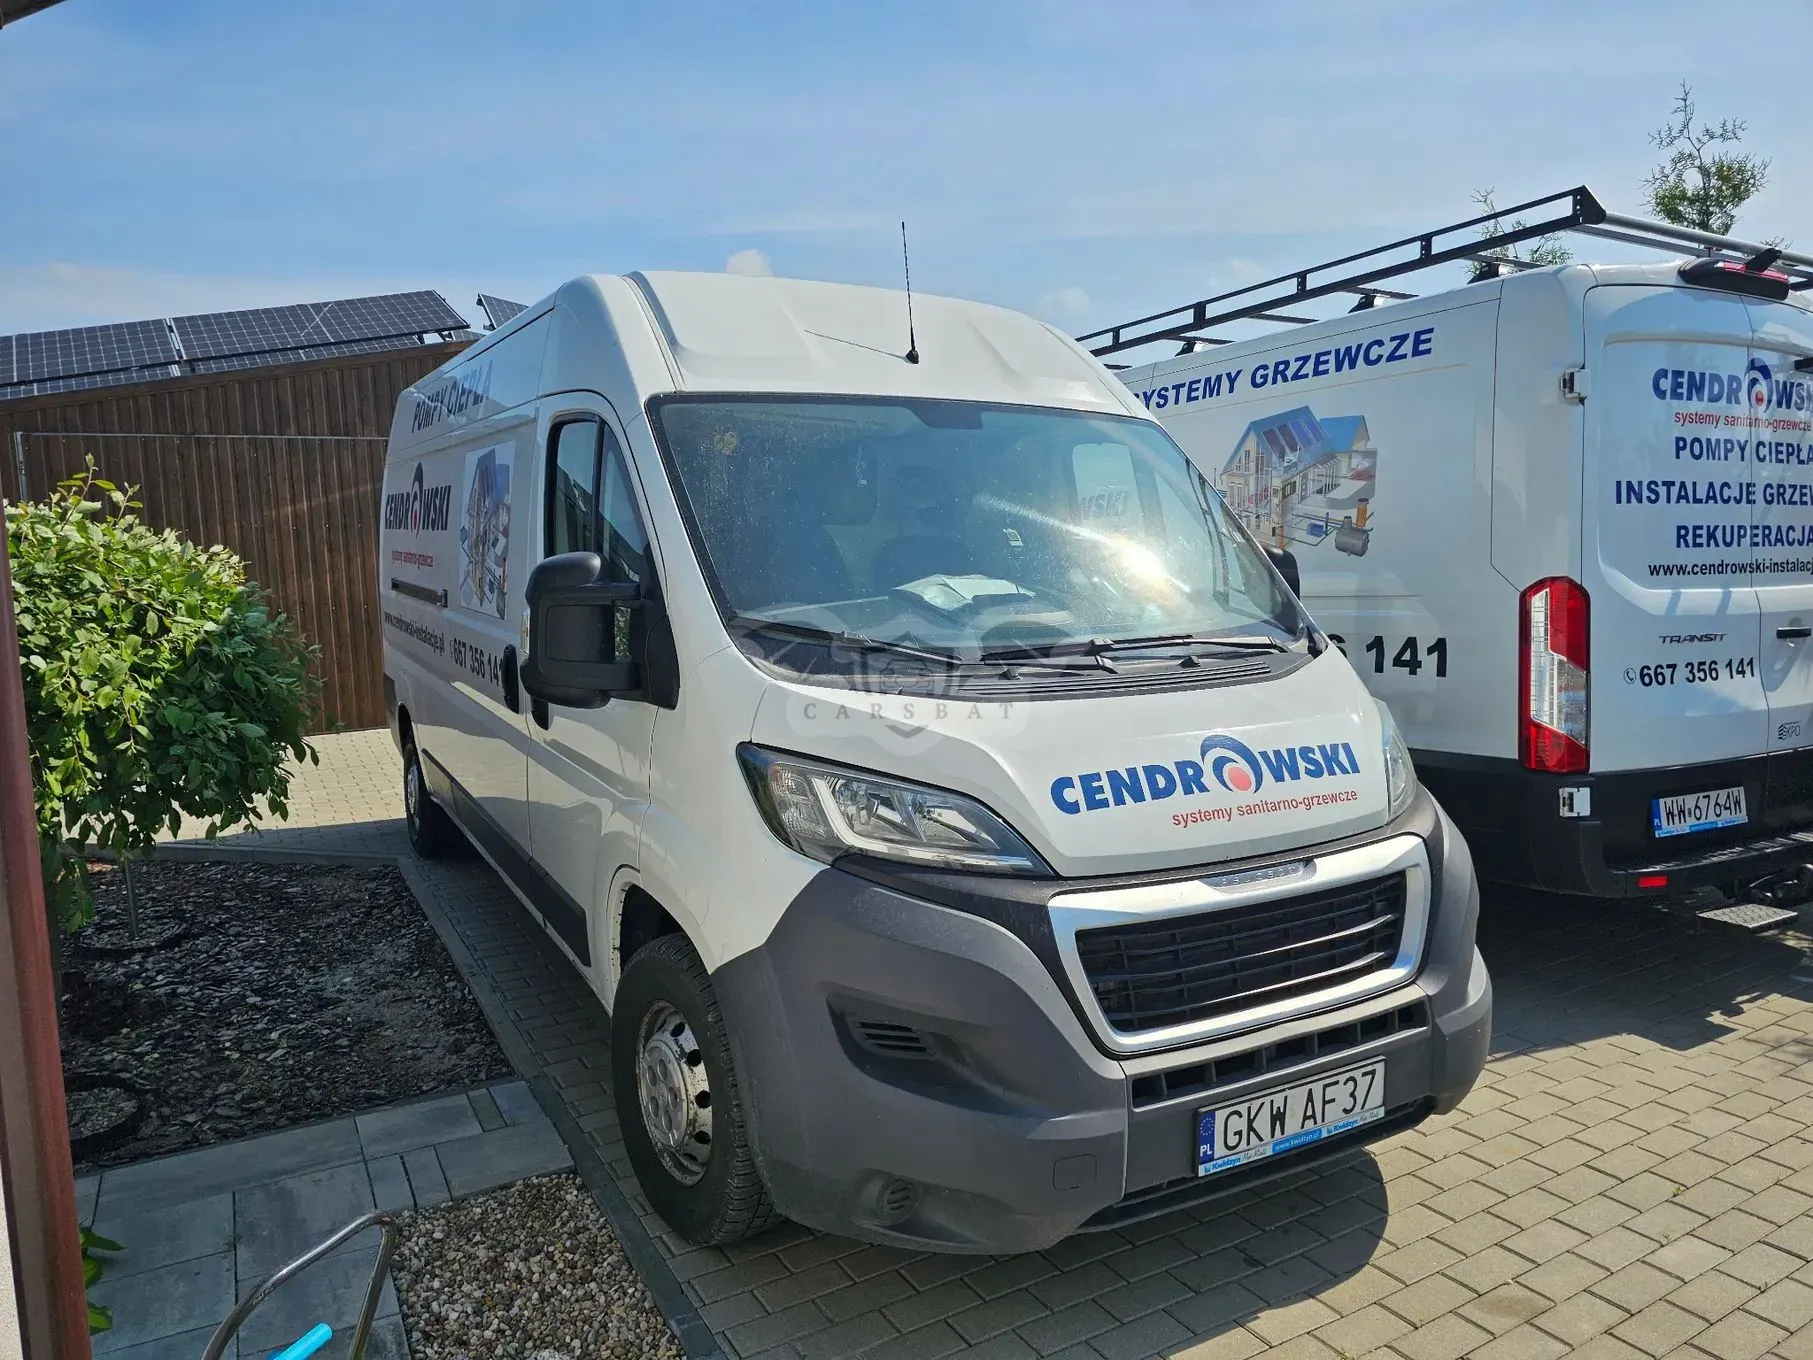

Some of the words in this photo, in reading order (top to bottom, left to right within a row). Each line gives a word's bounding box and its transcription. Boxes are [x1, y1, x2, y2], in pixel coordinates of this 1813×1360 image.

[1250, 327, 1434, 389] GRZEWCZE
[1674, 411, 1720, 429] systemy
[1724, 413, 1812, 432] sanitarno-grzewcze
[1675, 437, 1748, 461] POMPY
[1756, 441, 1813, 465] CIEPŁA
[385, 463, 451, 539] CENDROWSKI
[1615, 480, 1756, 505] INSTALACJE
[1763, 483, 1813, 506] GRZE
[1676, 525, 1813, 549] REKUPERACJA
[1366, 633, 1447, 678] 141
[1659, 633, 1727, 644] TRANSIT
[453, 638, 467, 668] 667
[469, 645, 486, 679] 356
[1640, 664, 1677, 687] 667
[1685, 660, 1719, 683] 356
[1725, 657, 1755, 679] 141
[1050, 734, 1360, 815] CENDROWSKI
[1172, 806, 1232, 828] systemy
[1237, 789, 1358, 817] sanitarno-grzewcze
[1223, 1095, 1288, 1151] GKW
[1300, 1068, 1377, 1129] AF37
[1200, 1143, 1213, 1157] PL
